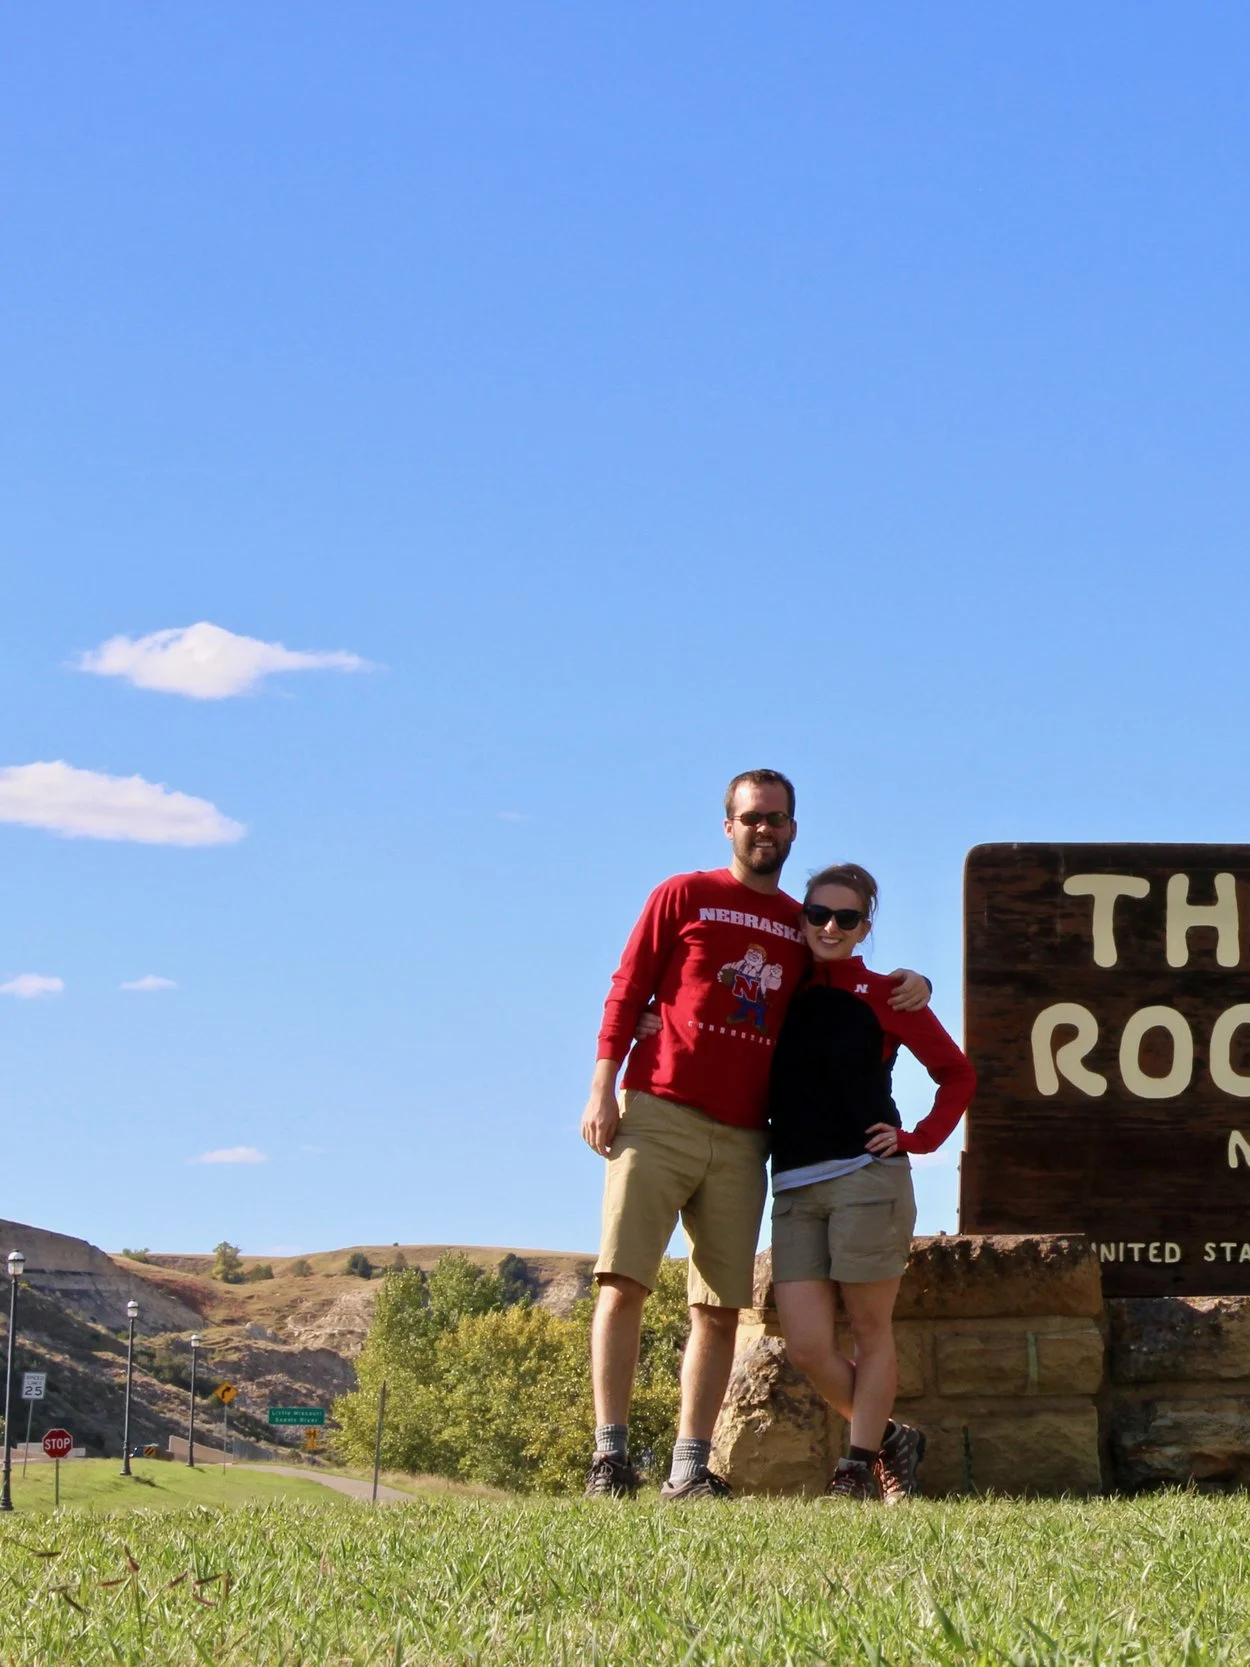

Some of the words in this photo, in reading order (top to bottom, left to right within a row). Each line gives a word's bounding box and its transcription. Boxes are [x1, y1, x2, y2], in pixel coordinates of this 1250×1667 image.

[732, 974, 760, 1003] N
[854, 983, 869, 994] N
[1091, 1242, 1181, 1264] NITED
[25, 1385, 42, 1396] 25
[44, 1437, 71, 1450] STOP
